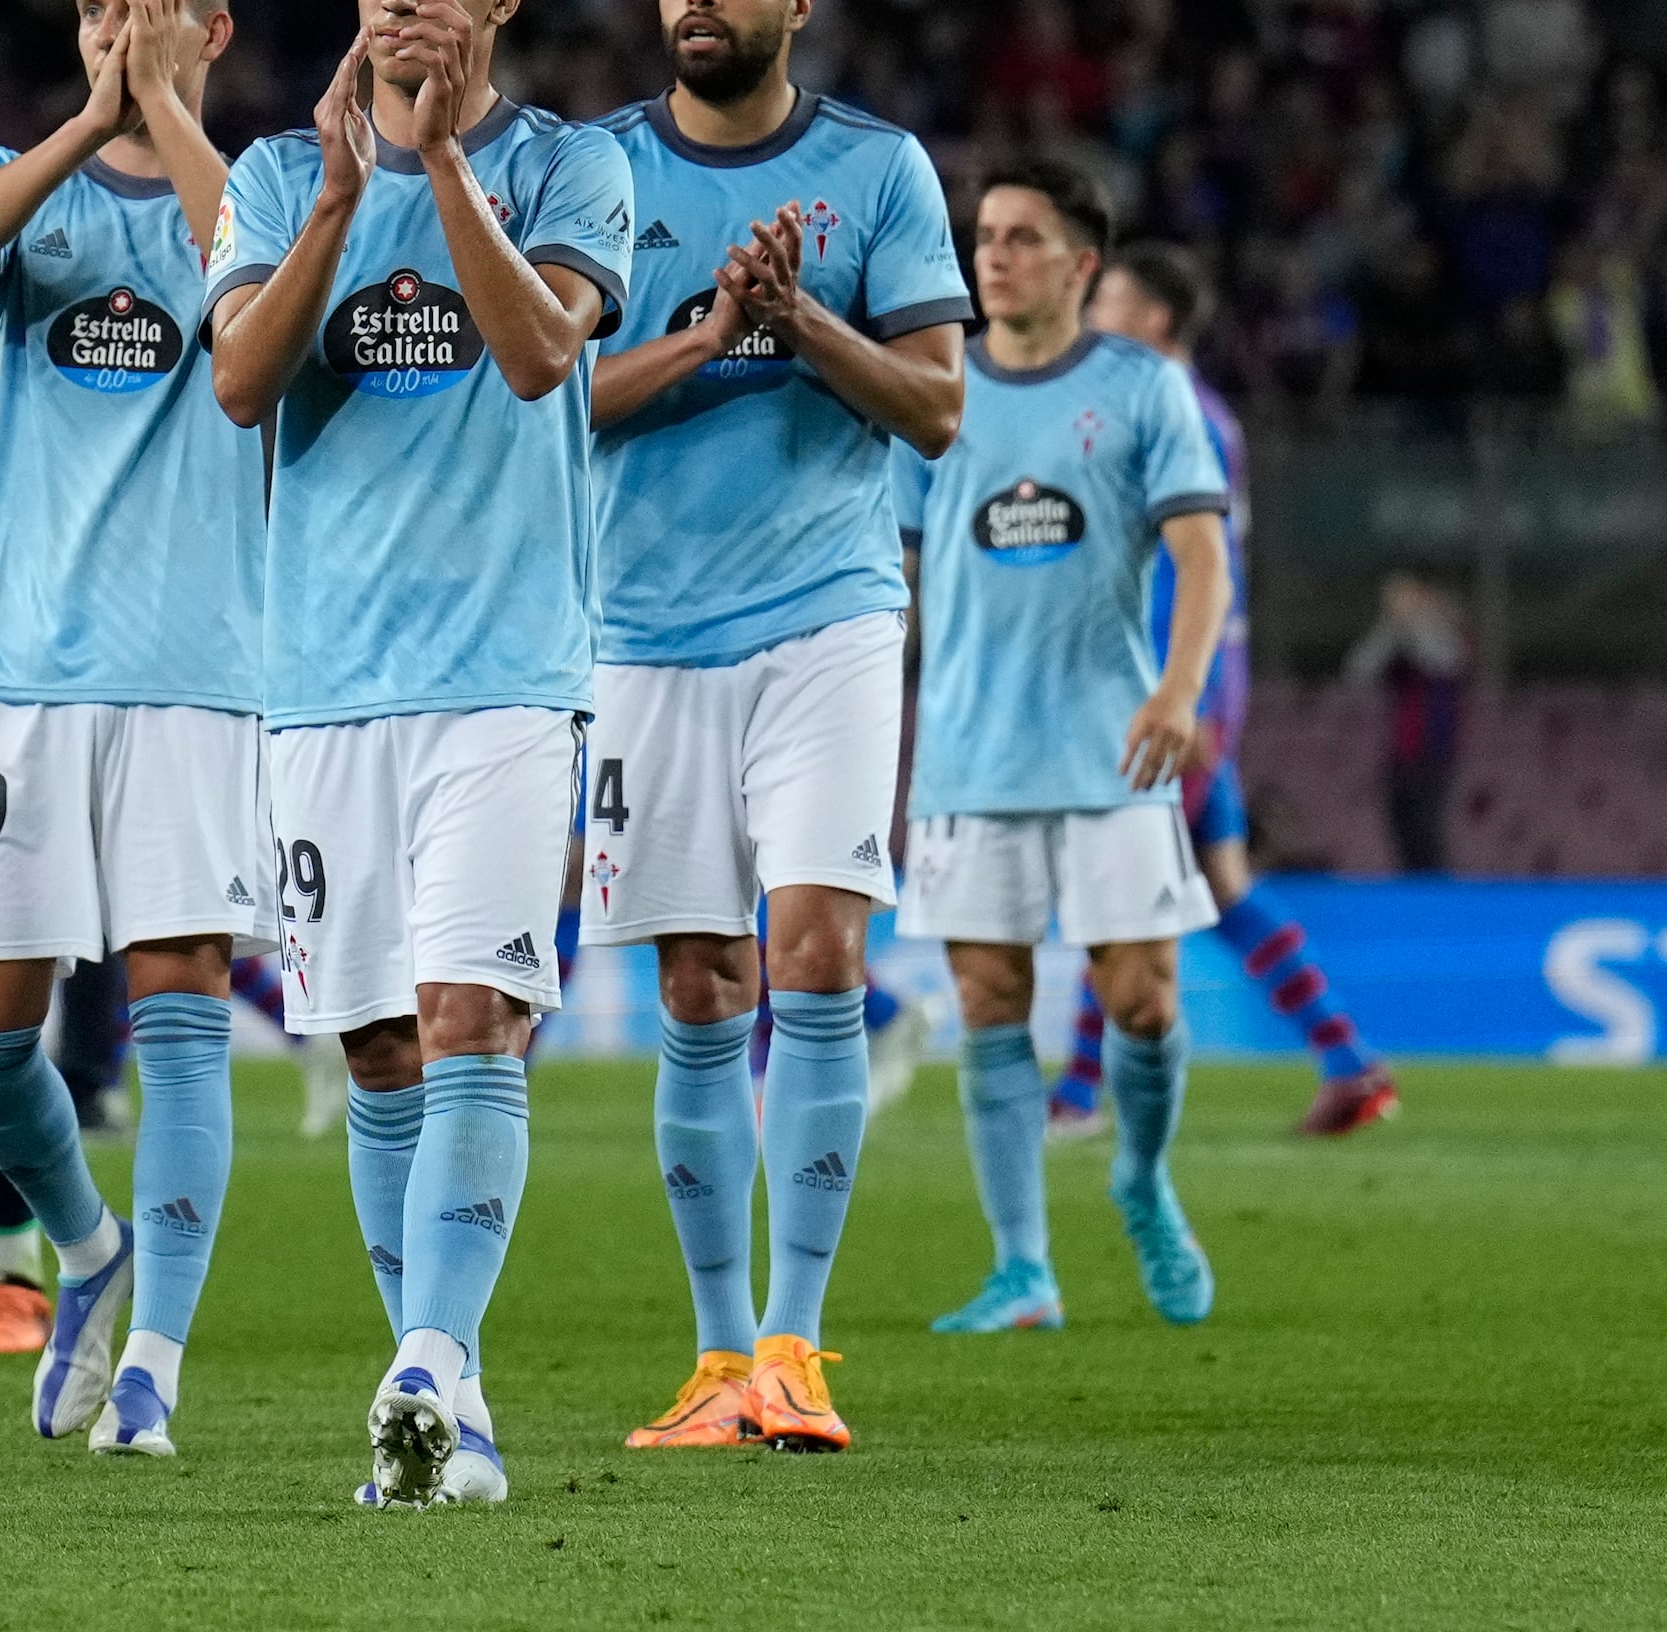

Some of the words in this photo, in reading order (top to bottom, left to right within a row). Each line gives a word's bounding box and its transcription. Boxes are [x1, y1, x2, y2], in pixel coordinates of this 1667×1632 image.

[574, 217, 594, 229] AIX
[29, 244, 73, 259] adidas
[70, 312, 162, 343] Estrella
[350, 305, 460, 335] Estrella
[72, 338, 156, 368] Galicia
[354, 335, 454, 366] Galicia
[96, 368, 127, 389] 0,0
[386, 367, 420, 393] 0,0
[851, 850, 882, 868] adidas
[496, 948, 540, 969] adidas
[142, 1211, 208, 1234] adidas
[440, 1211, 508, 1240] adidas
